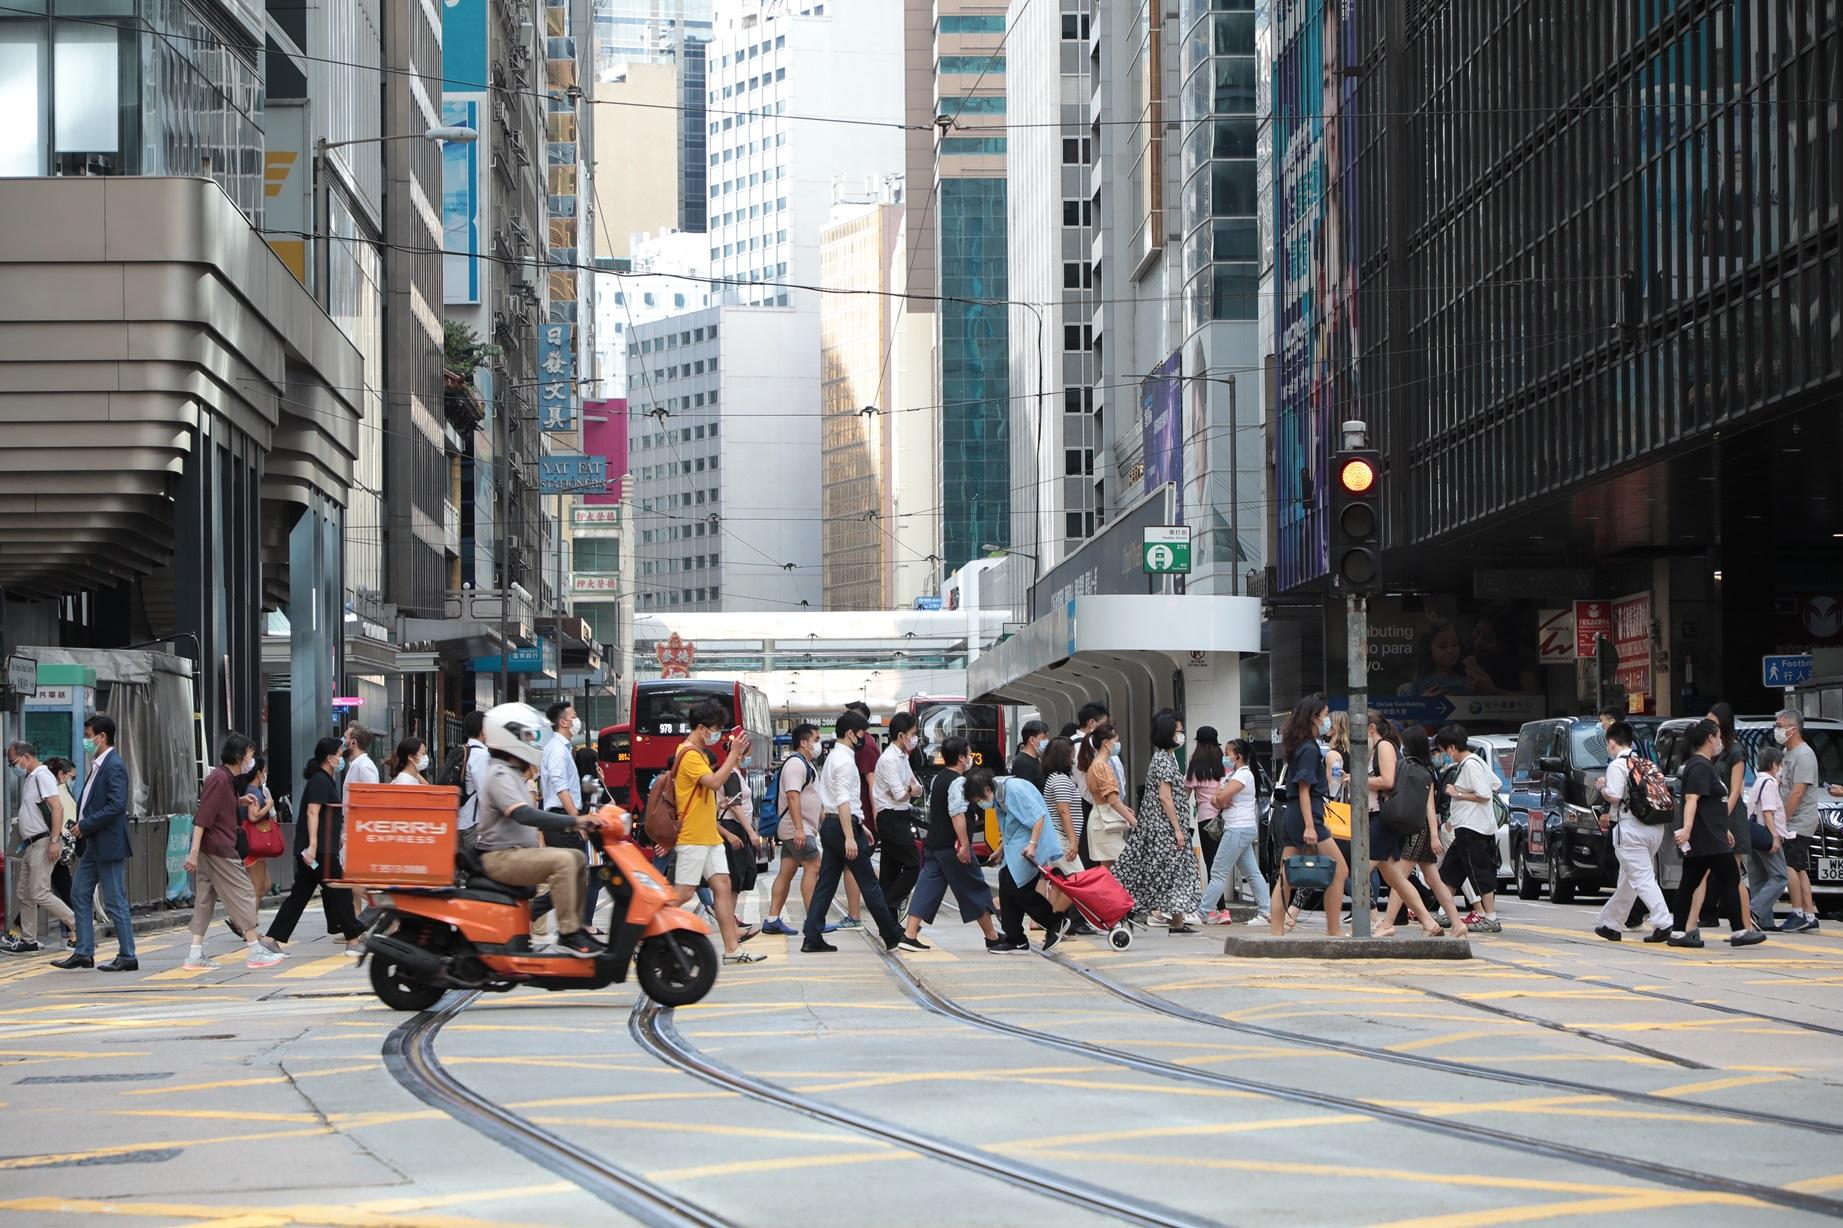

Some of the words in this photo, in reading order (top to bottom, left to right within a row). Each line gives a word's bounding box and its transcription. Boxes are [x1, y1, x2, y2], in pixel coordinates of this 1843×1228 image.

[541, 326, 567, 429] 日發文具
[542, 462, 569, 475] YAT
[1382, 644, 1413, 657] para
[659, 723, 673, 734] 978
[355, 820, 448, 834] KERRY
[366, 834, 436, 844] EXPRESS
